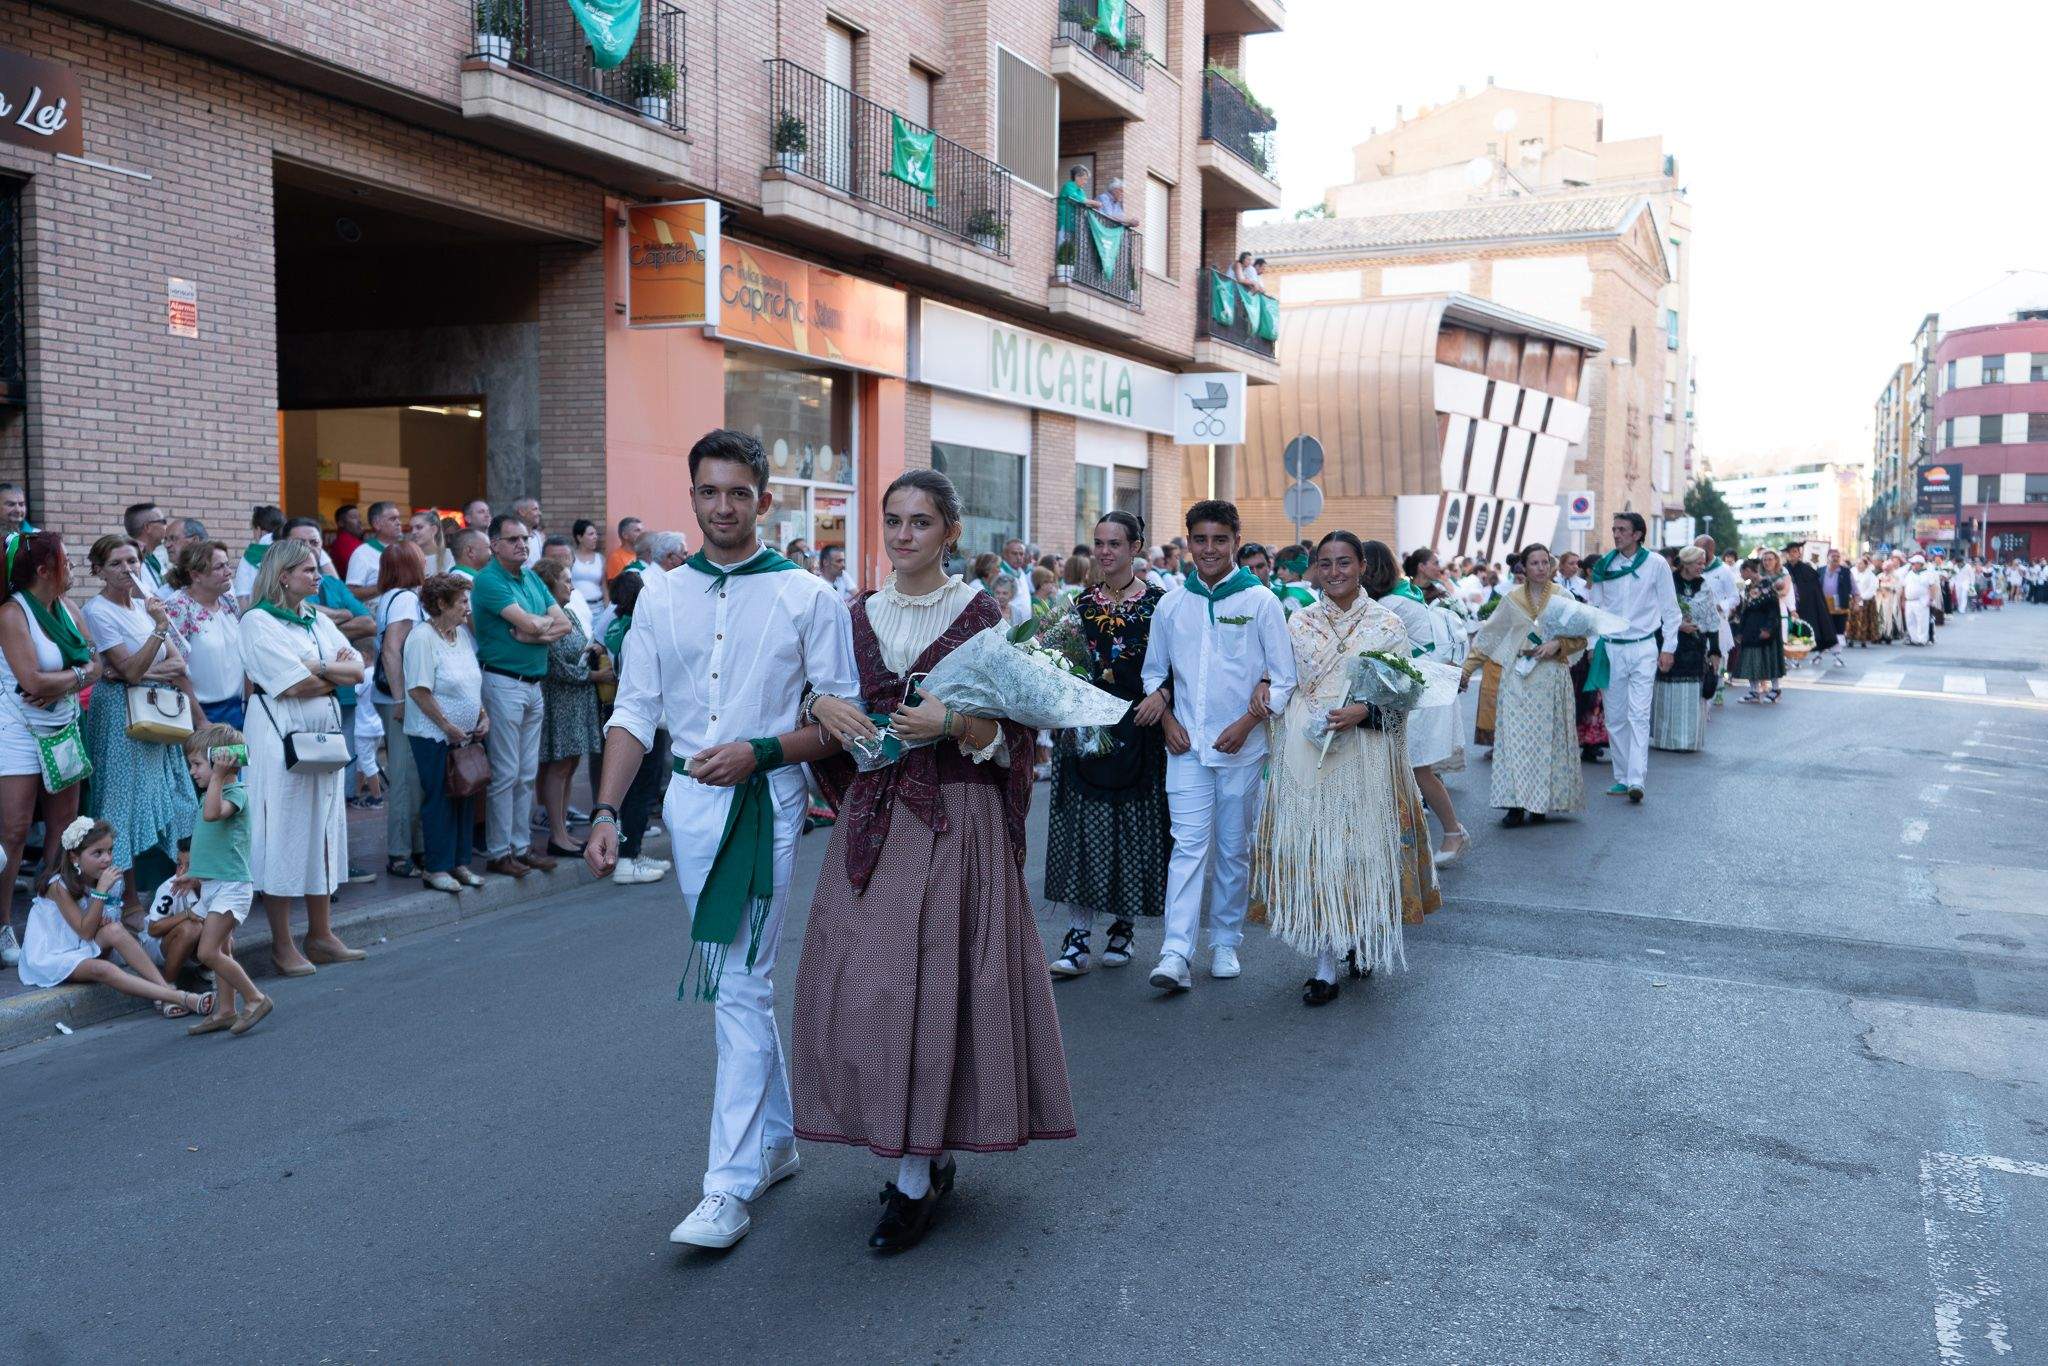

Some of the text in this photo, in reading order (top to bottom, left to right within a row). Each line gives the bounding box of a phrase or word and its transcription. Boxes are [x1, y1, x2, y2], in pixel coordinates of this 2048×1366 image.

[16, 86, 67, 135] Lei
[629, 244, 705, 271] Capricho
[719, 264, 806, 322] Capricho
[992, 329, 1131, 417] MICAELA
[156, 895, 173, 915] 3
